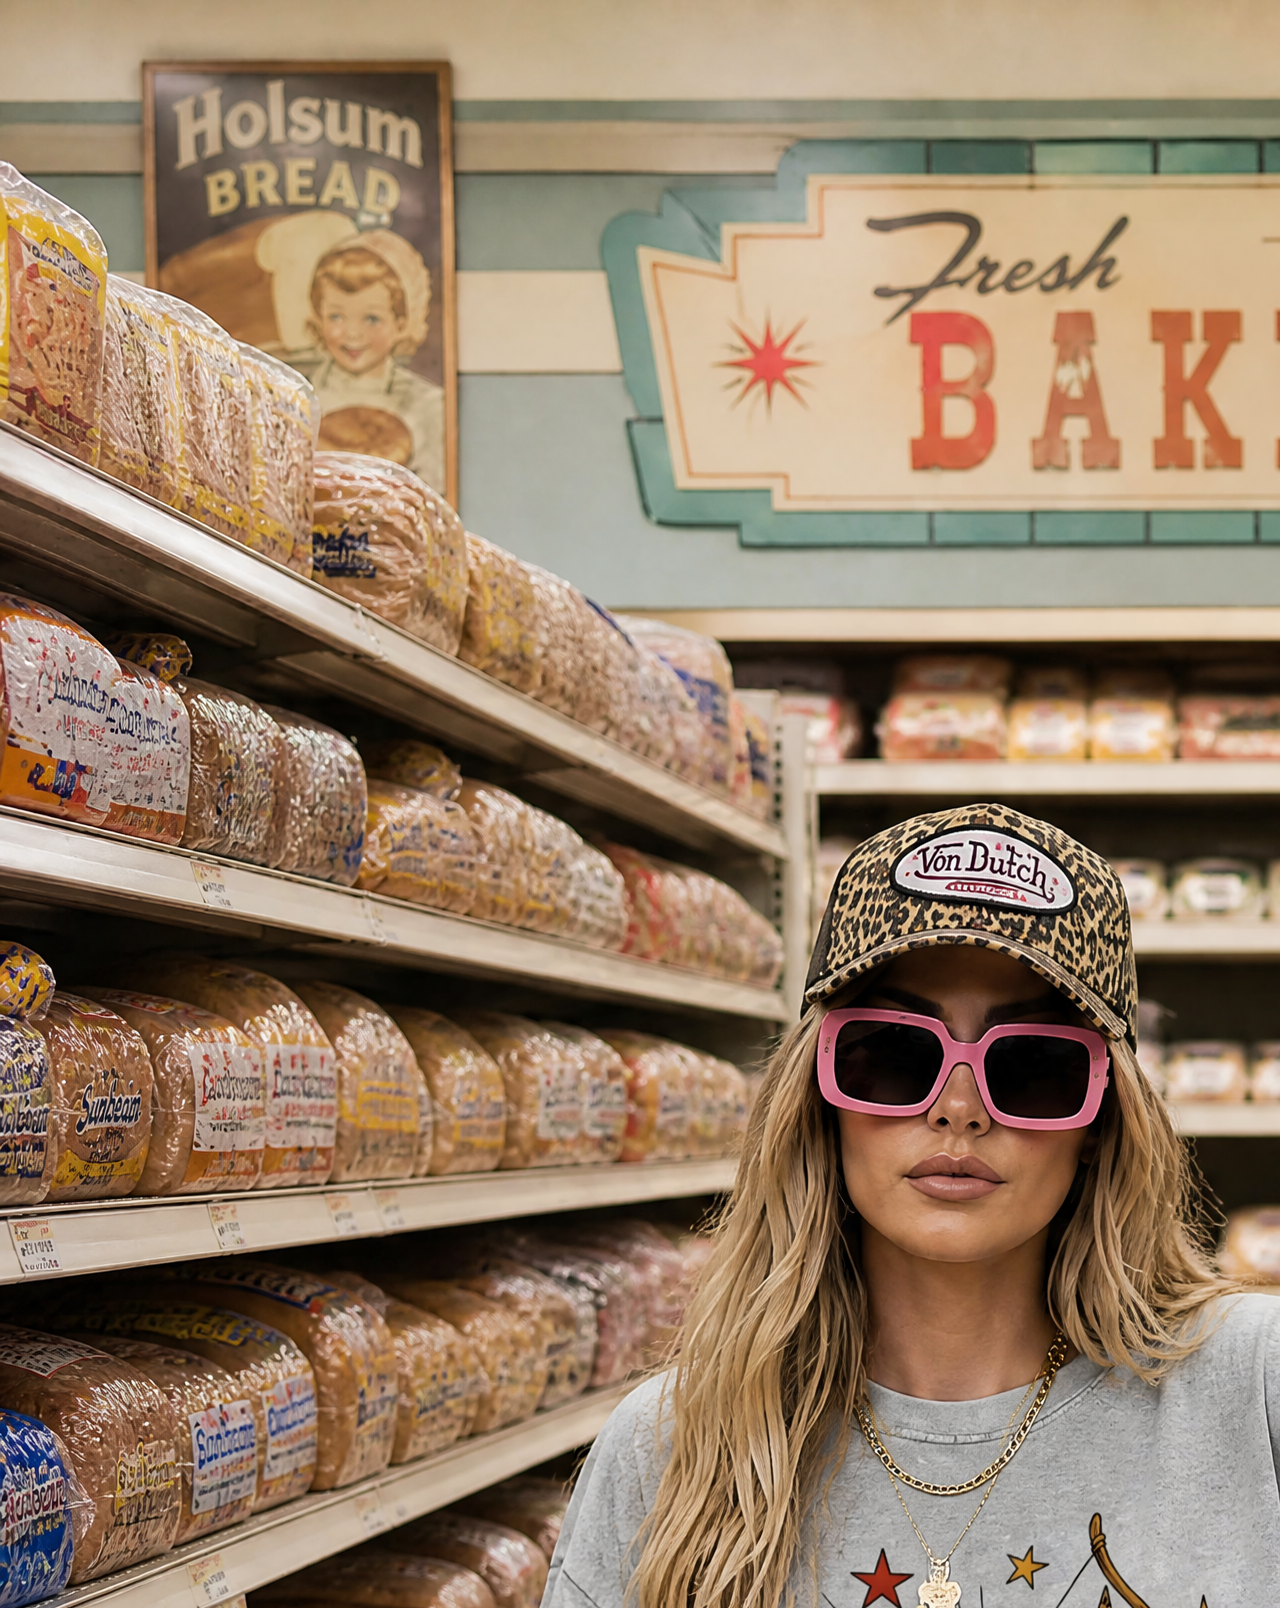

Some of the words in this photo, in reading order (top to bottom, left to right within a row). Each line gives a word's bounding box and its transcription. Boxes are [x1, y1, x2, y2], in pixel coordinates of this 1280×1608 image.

[172, 79, 424, 171] Holsum
[204, 157, 400, 217] BREAD
[866, 211, 1128, 326] Fresh
[916, 841, 963, 876] Von
[965, 840, 1052, 893] Dutch
